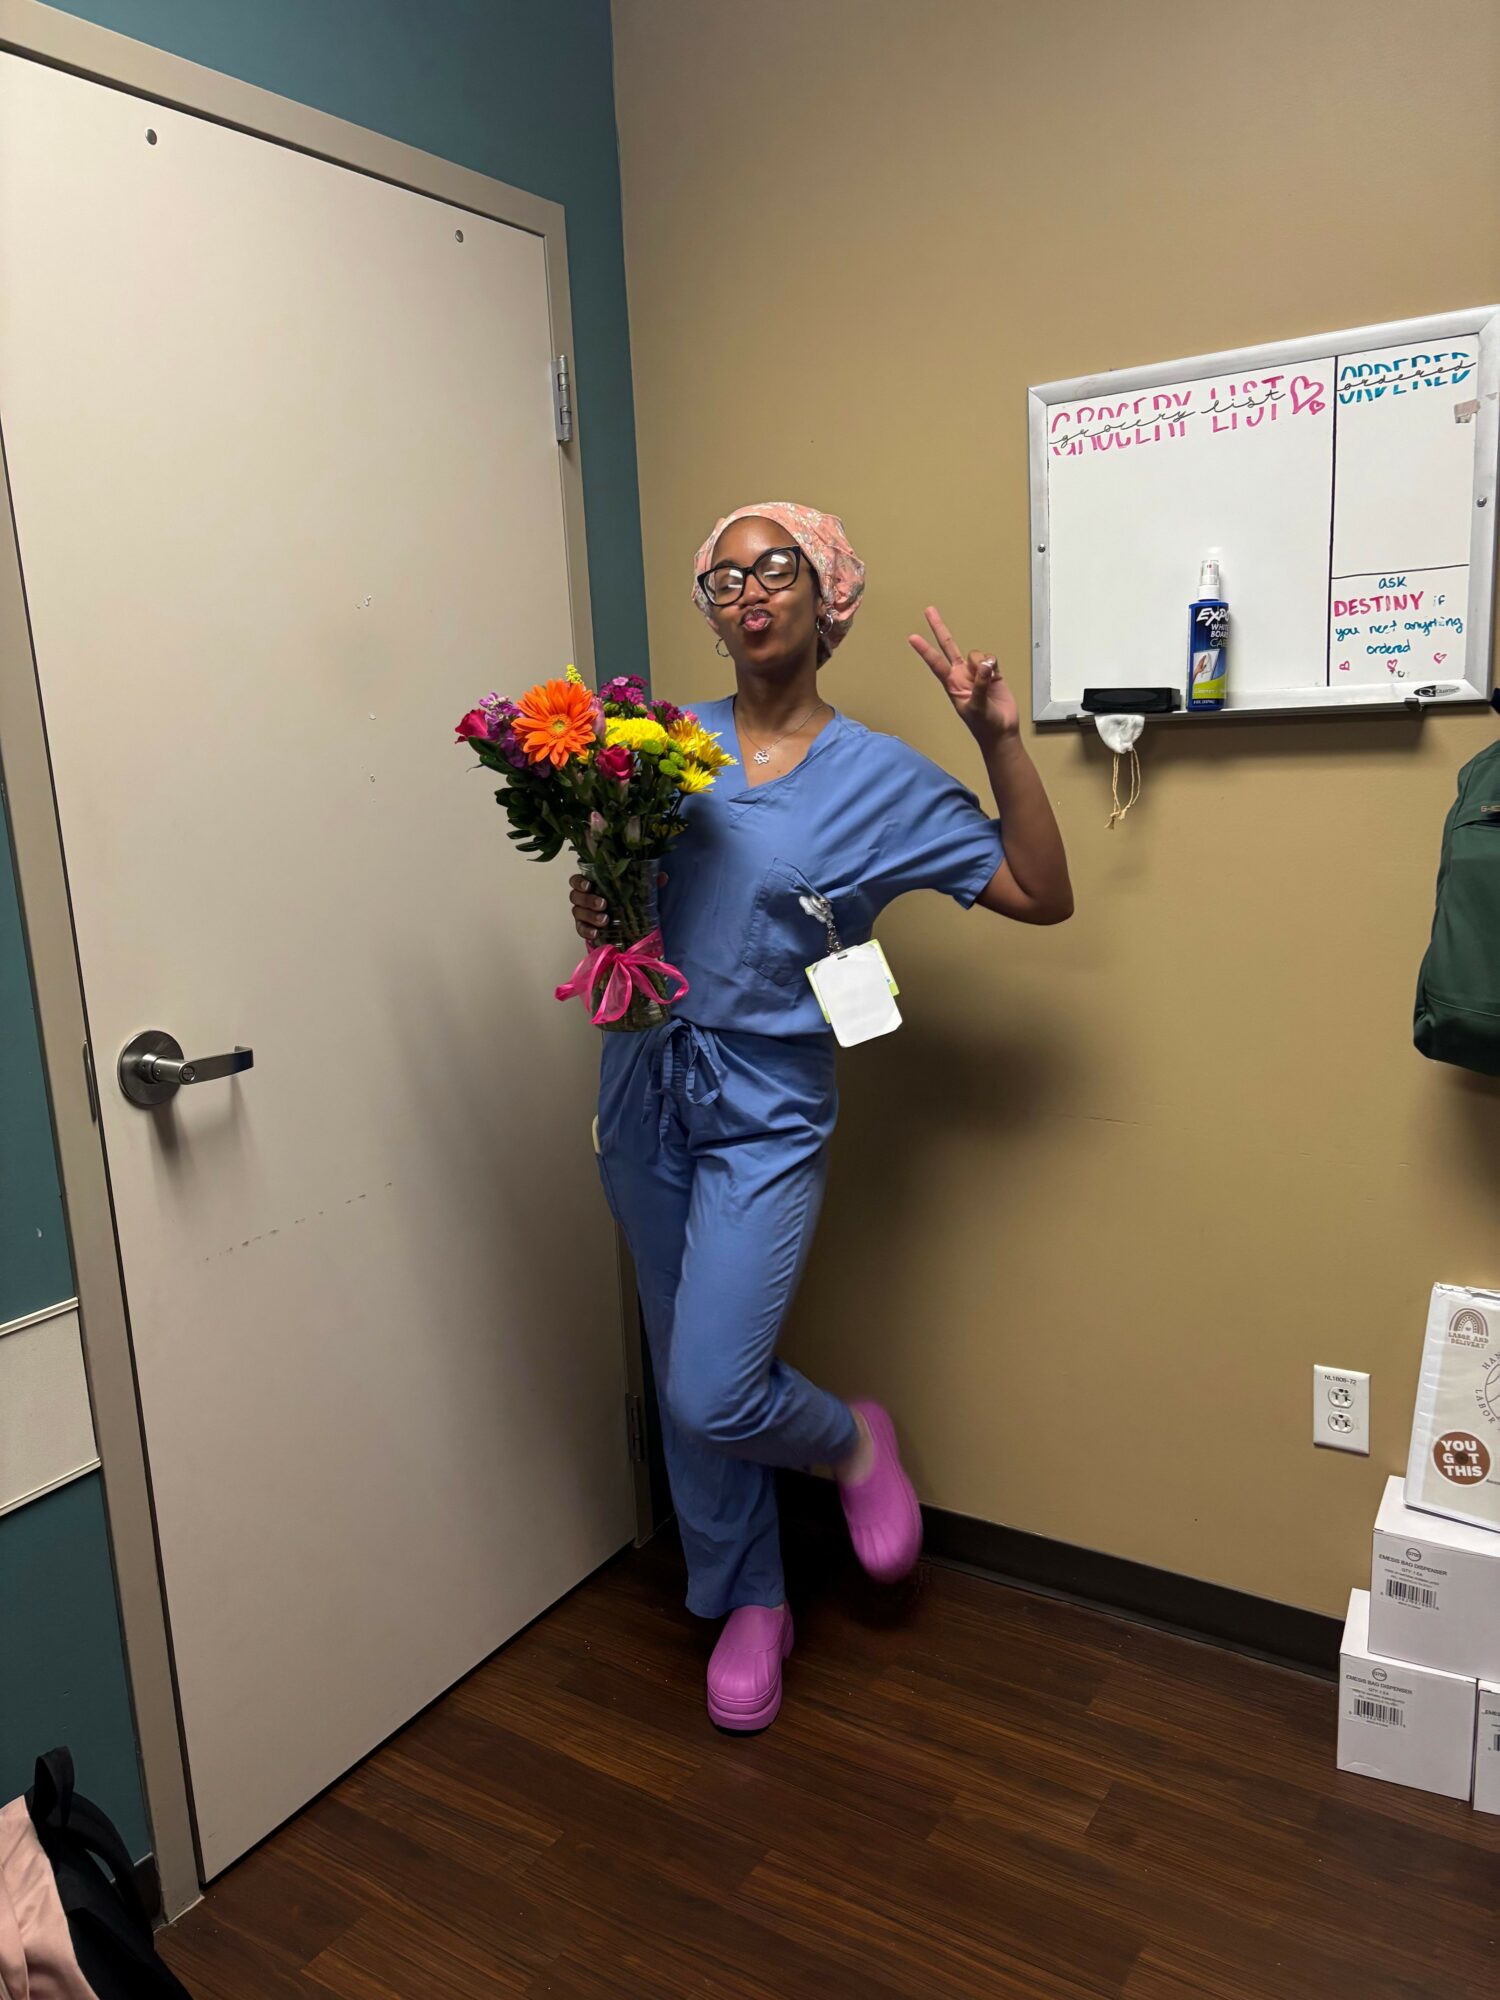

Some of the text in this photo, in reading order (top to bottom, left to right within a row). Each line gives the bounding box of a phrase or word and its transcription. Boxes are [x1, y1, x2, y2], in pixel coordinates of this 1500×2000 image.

[1378, 576, 1407, 589] ask
[1333, 591, 1424, 617] DESTINY
[1336, 627, 1360, 641] you
[1366, 639, 1411, 655] ordered
[1440, 1440, 1477, 1452] YOU
[1443, 1465, 1483, 1477] THIS
